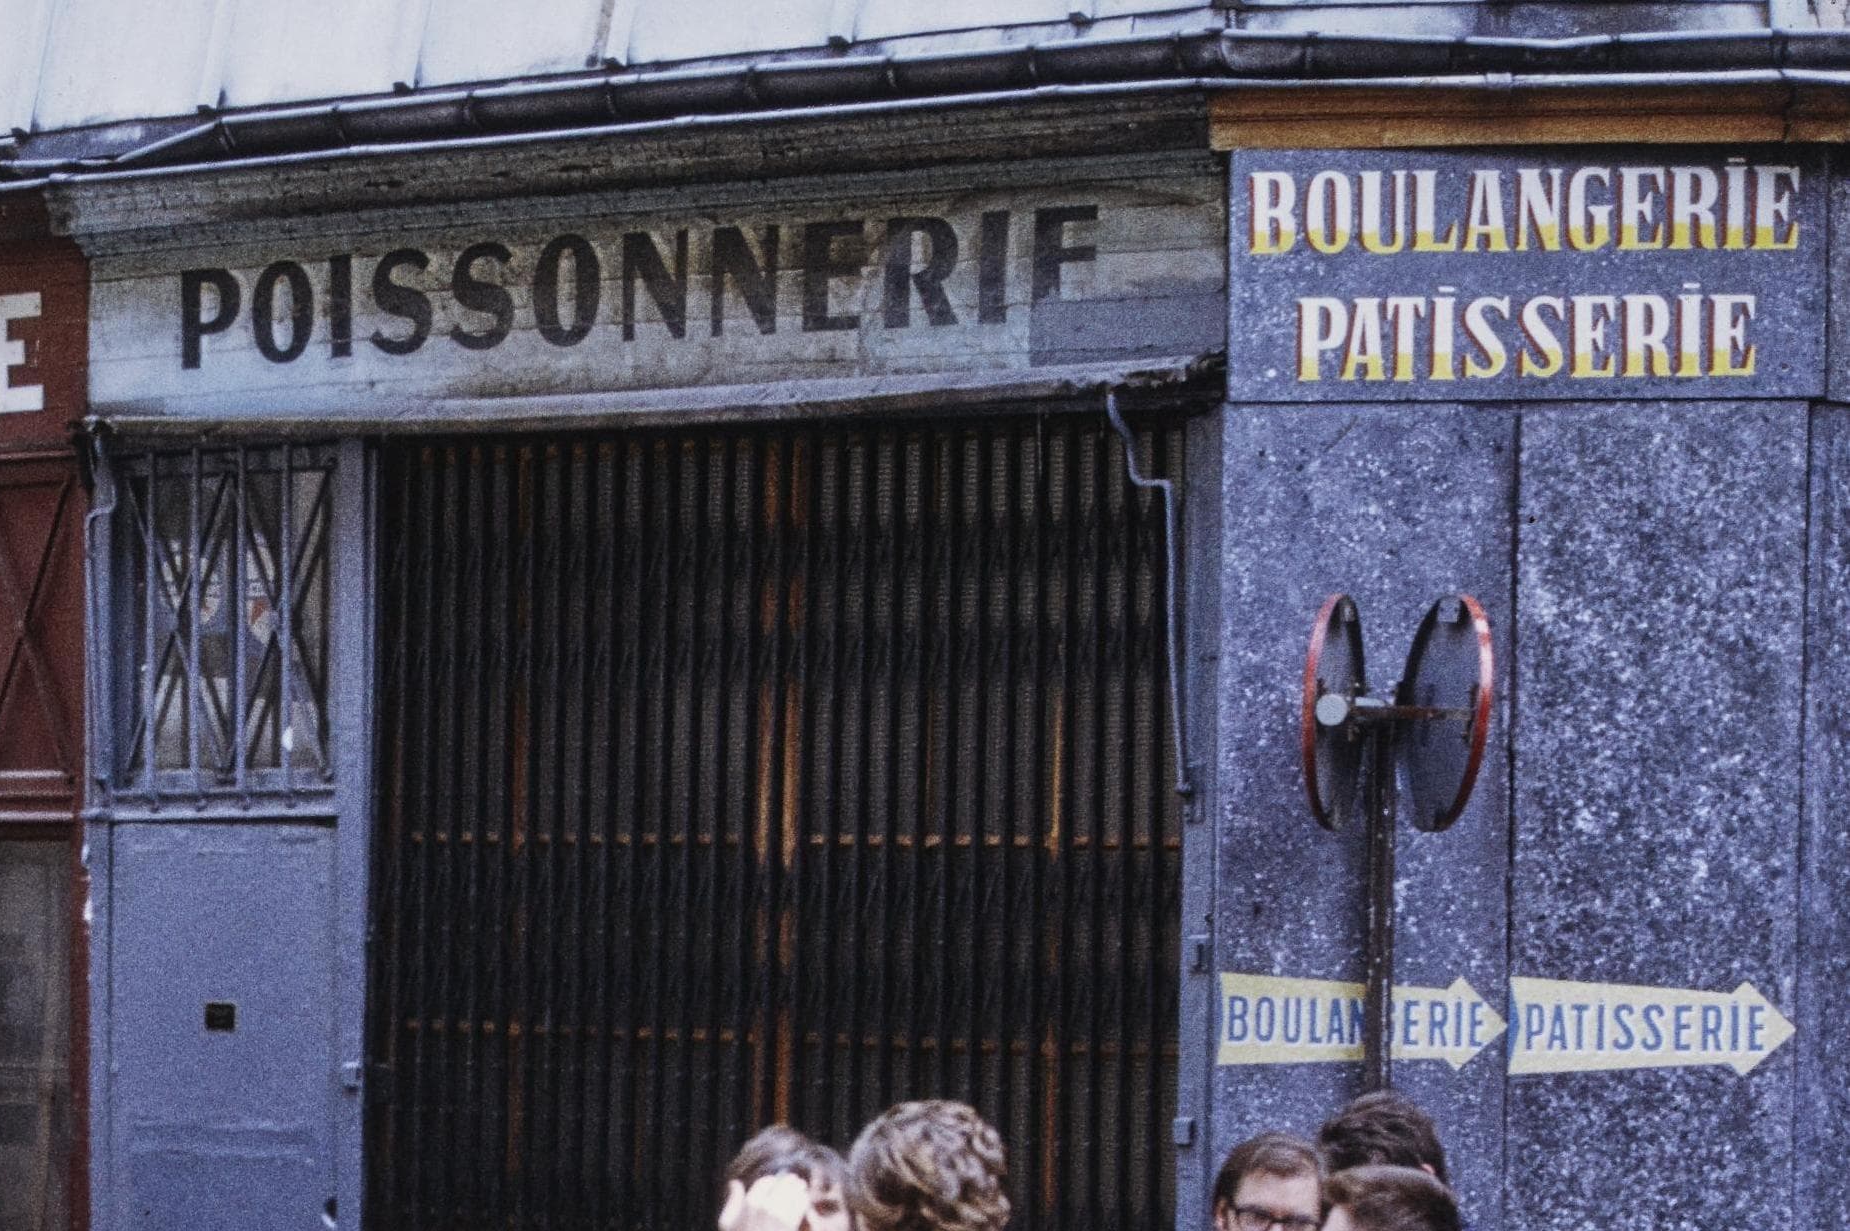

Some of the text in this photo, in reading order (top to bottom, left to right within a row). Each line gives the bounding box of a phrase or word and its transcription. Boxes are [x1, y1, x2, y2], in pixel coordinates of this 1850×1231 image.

[1249, 157, 1801, 256] BOULANGERIE
[1297, 285, 1756, 383] PATISSERIE
[1227, 995, 1485, 1047] BOULANERIE
[1524, 1002, 1764, 1052] PATISSERIE
